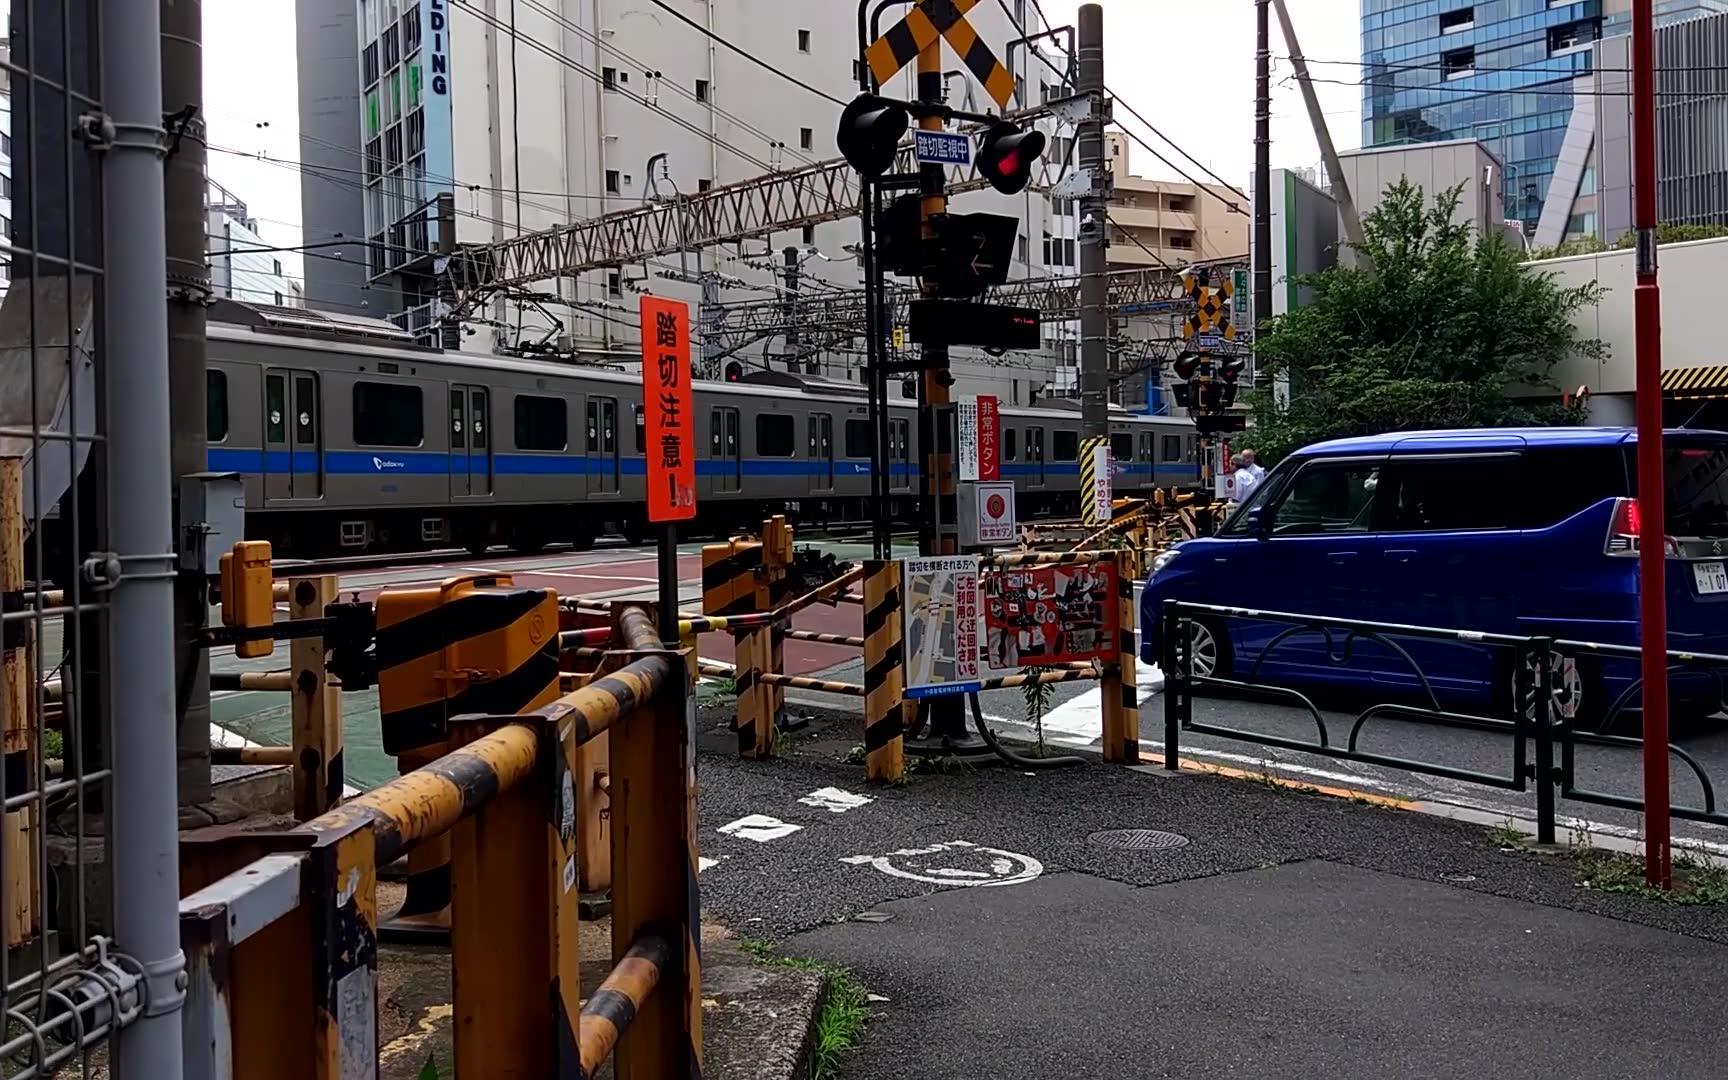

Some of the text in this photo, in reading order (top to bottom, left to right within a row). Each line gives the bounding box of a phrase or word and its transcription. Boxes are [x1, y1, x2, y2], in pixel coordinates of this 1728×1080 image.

[431, 0, 447, 95] LDING
[918, 136, 967, 160] 踏切監視中
[656, 311, 682, 508] 踏切注意！
[981, 402, 994, 475] 非常ボタン
[909, 560, 976, 572] 踏切を横断される方へ
[957, 576, 966, 676] ご利用ください
[966, 576, 977, 676] 左図の迂回路も
